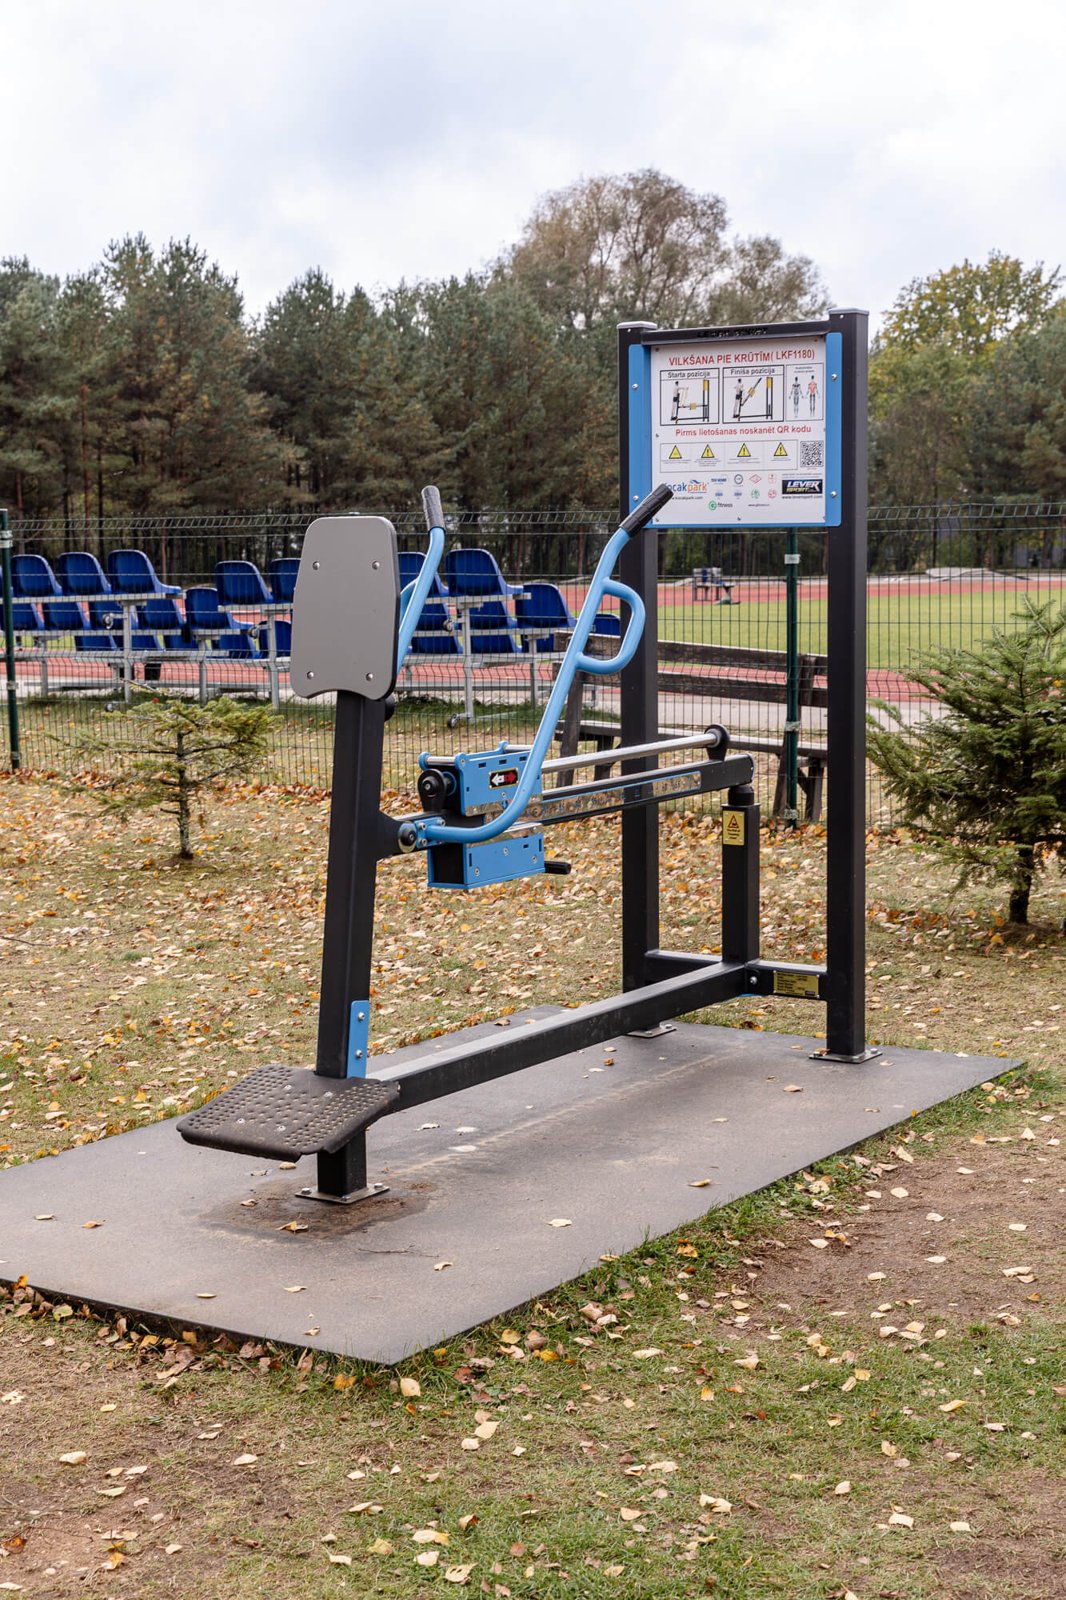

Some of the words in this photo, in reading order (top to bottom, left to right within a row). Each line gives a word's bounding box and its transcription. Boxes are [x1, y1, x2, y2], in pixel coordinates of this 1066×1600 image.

[669, 355, 714, 366] VILKŠANA
[717, 354, 731, 364] PIE
[668, 371, 686, 379] Starta
[676, 428, 696, 437] Pirms
[699, 427, 737, 436] lietošanas
[777, 425, 789, 434] QR
[791, 425, 811, 433] kodu
[665, 482, 707, 493] ocakpark
[787, 480, 821, 491] LEVER
